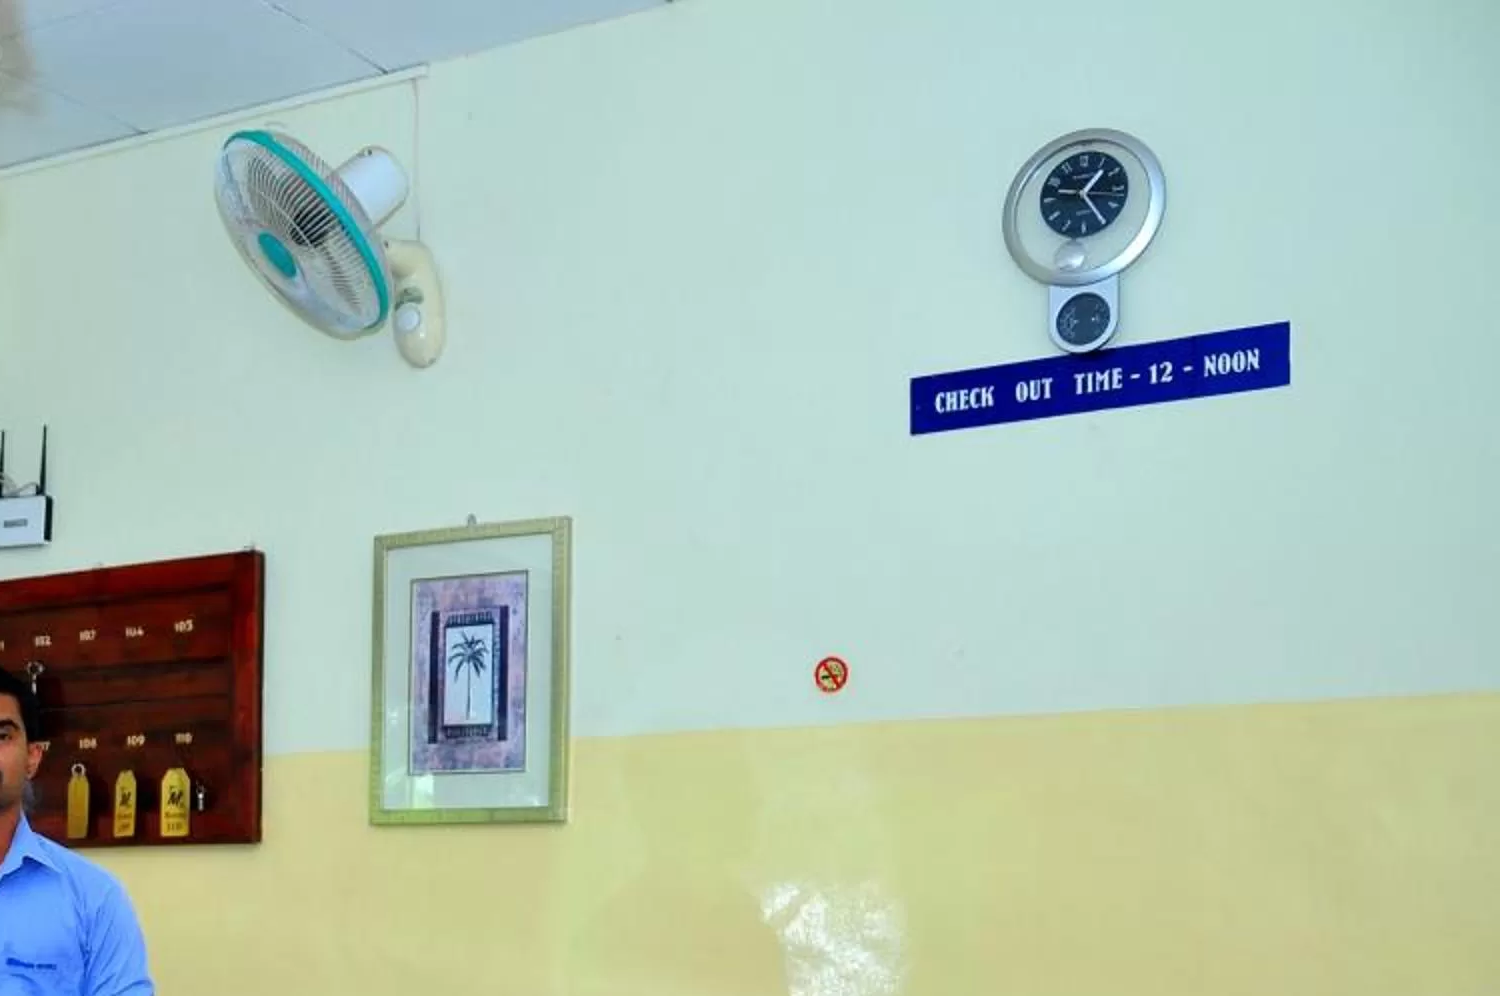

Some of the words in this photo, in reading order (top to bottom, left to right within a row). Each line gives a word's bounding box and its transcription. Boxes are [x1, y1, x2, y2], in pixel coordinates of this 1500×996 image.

[935, 386, 995, 414] CHECK
[1015, 377, 1053, 403] OUT
[1073, 367, 1123, 396] TIME
[1149, 361, 1173, 385] 12
[1204, 348, 1261, 378] NOON
[127, 733, 145, 748] 109
